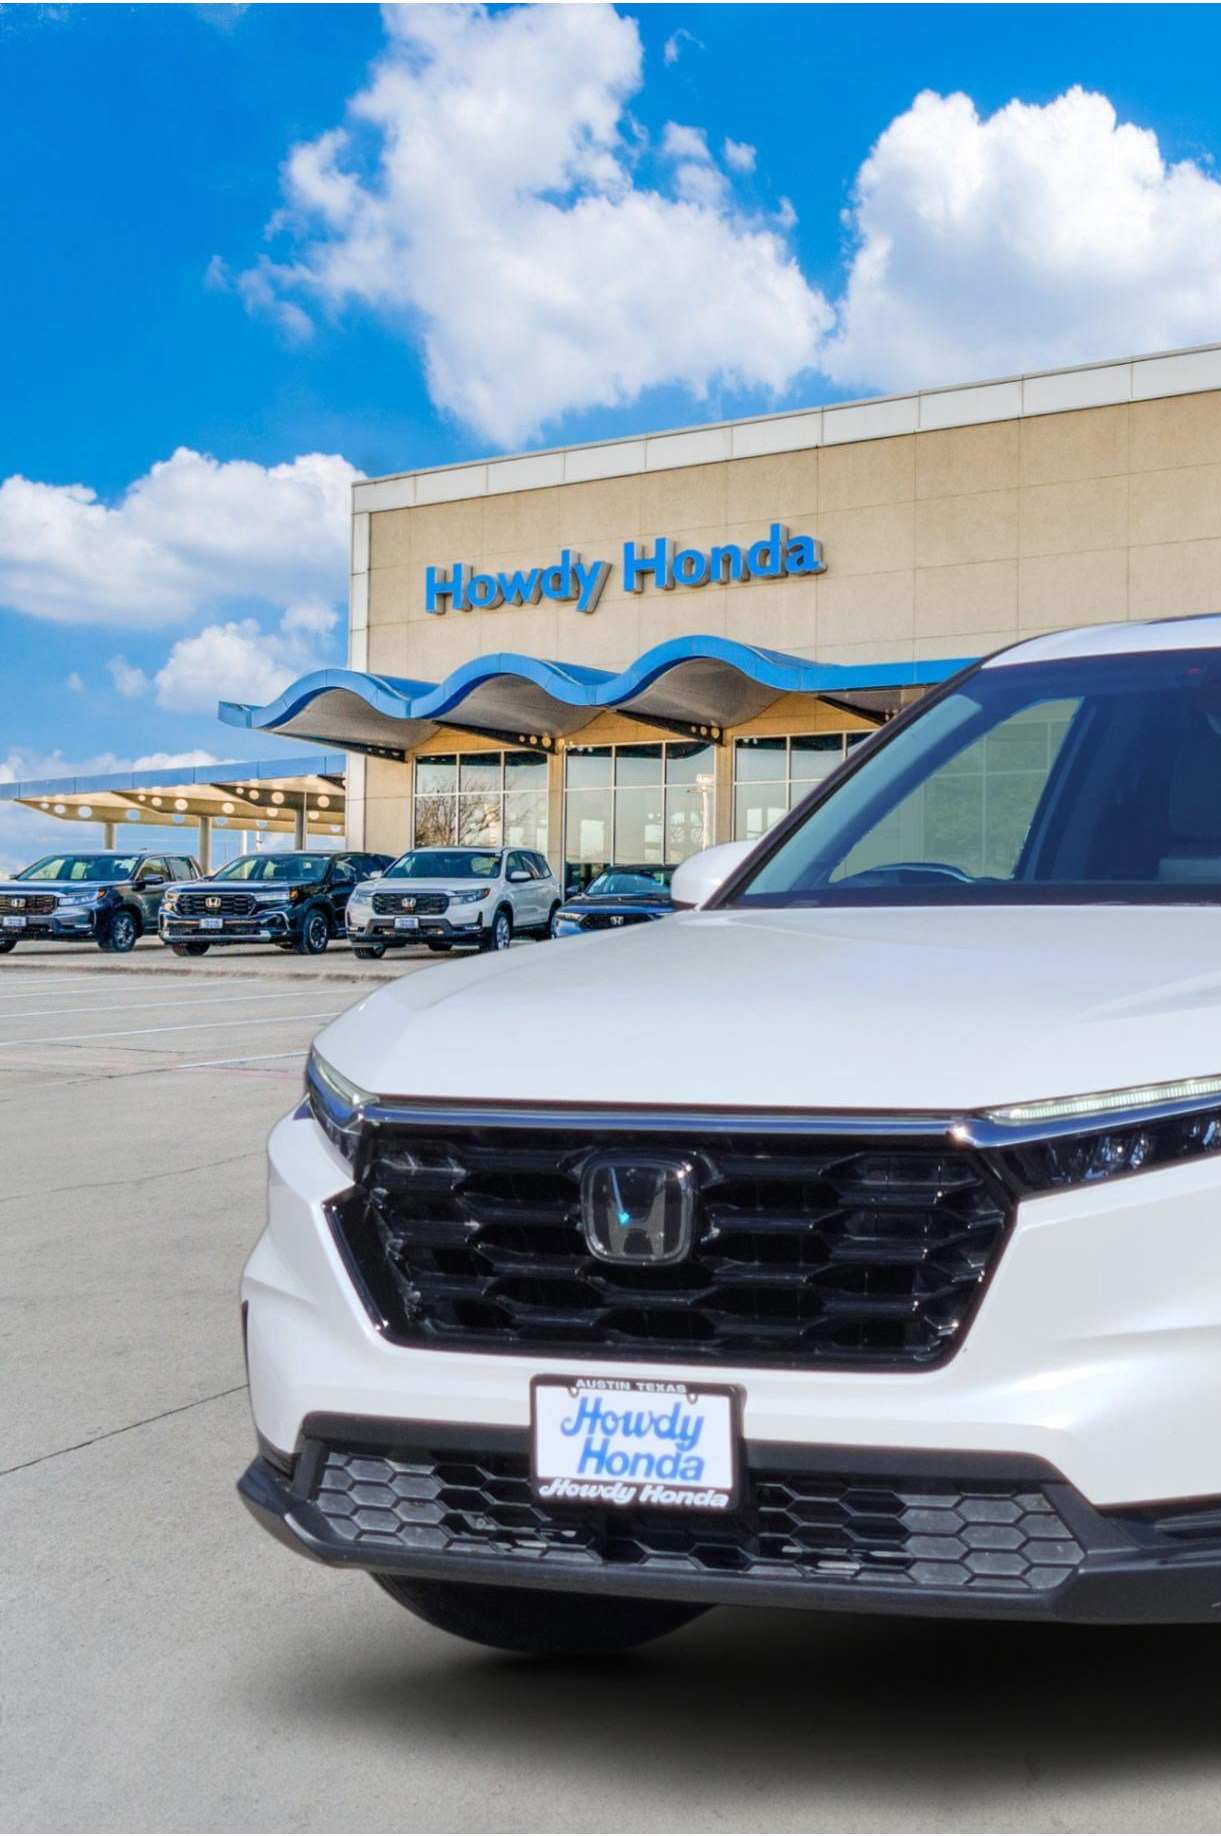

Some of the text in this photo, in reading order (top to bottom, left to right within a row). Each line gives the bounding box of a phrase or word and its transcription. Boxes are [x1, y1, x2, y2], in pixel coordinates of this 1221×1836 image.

[425, 523, 826, 614] Howdy Honda
[576, 1378, 687, 1394] AUSTIN TEXAS
[560, 1396, 704, 1451] Howdy
[577, 1437, 705, 1481] Honda
[539, 1478, 729, 1508] Howdy Honda
